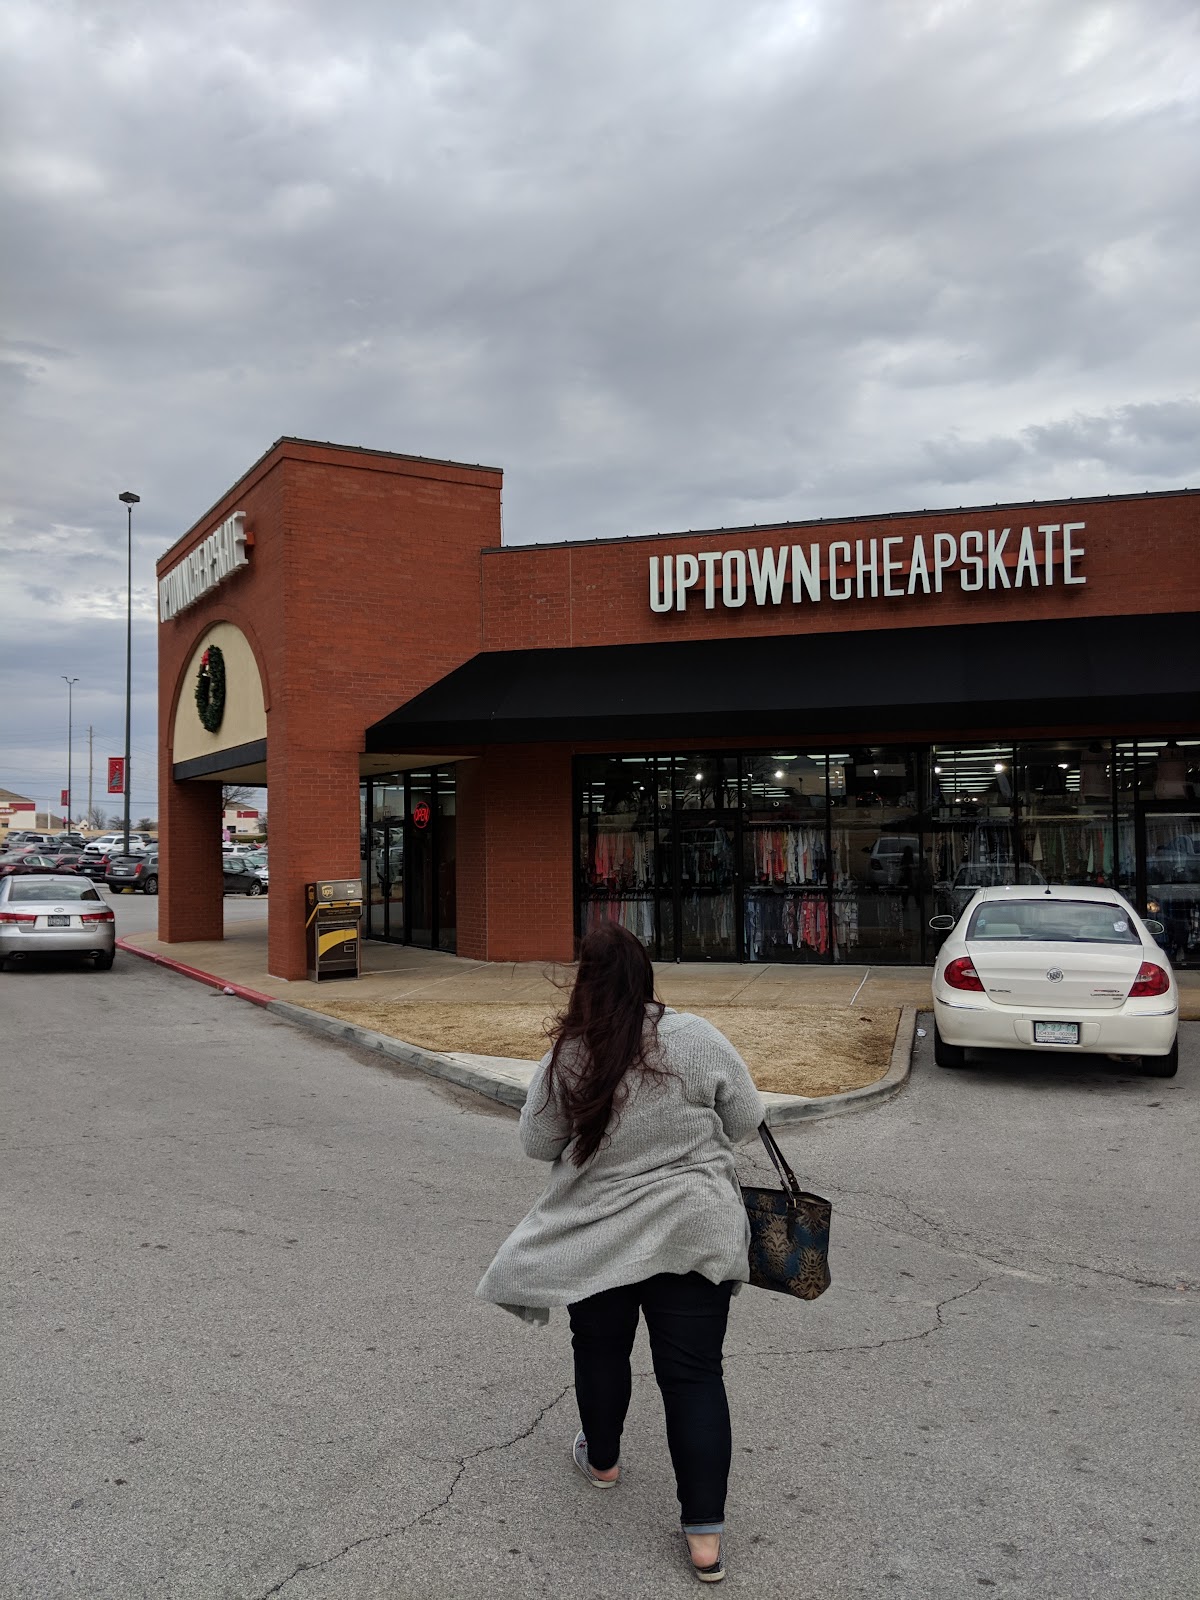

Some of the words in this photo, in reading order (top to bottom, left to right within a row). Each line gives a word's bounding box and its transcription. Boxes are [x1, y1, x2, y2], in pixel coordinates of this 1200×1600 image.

[649, 543, 821, 613] UPTOWN
[829, 522, 1087, 600] CHEAPSKATE
[414, 808, 430, 821] OPEN
